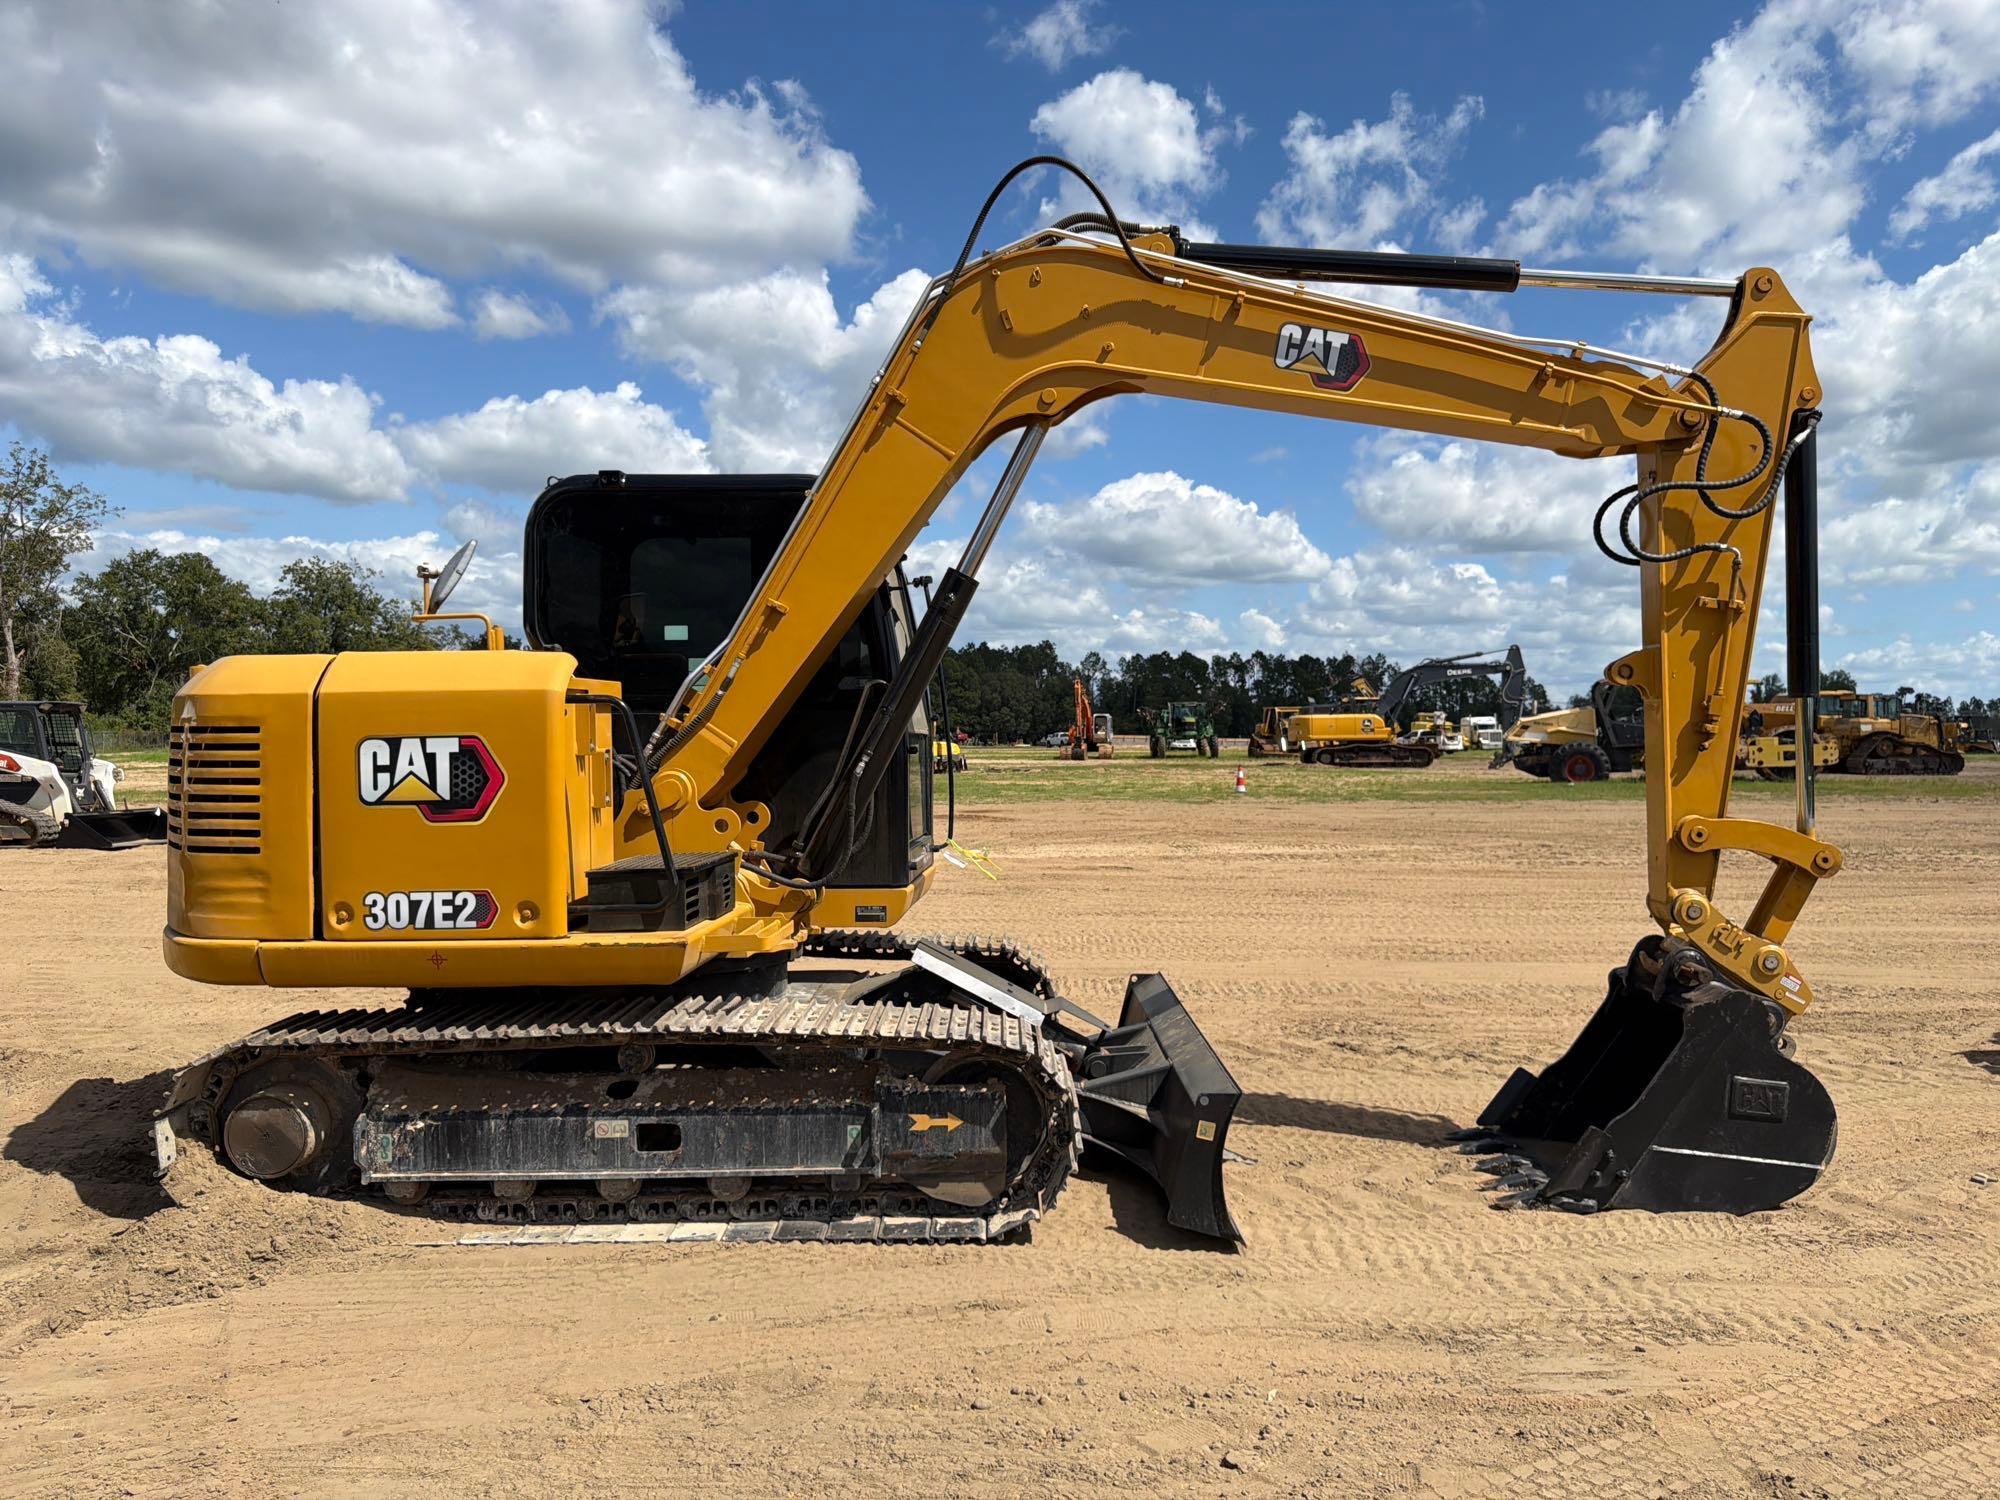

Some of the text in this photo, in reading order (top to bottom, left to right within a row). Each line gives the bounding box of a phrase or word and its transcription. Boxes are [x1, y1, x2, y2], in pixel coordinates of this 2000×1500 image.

[1276, 323, 1350, 376] CAT
[359, 737, 460, 802] CAT
[364, 891, 478, 930] 307E2
